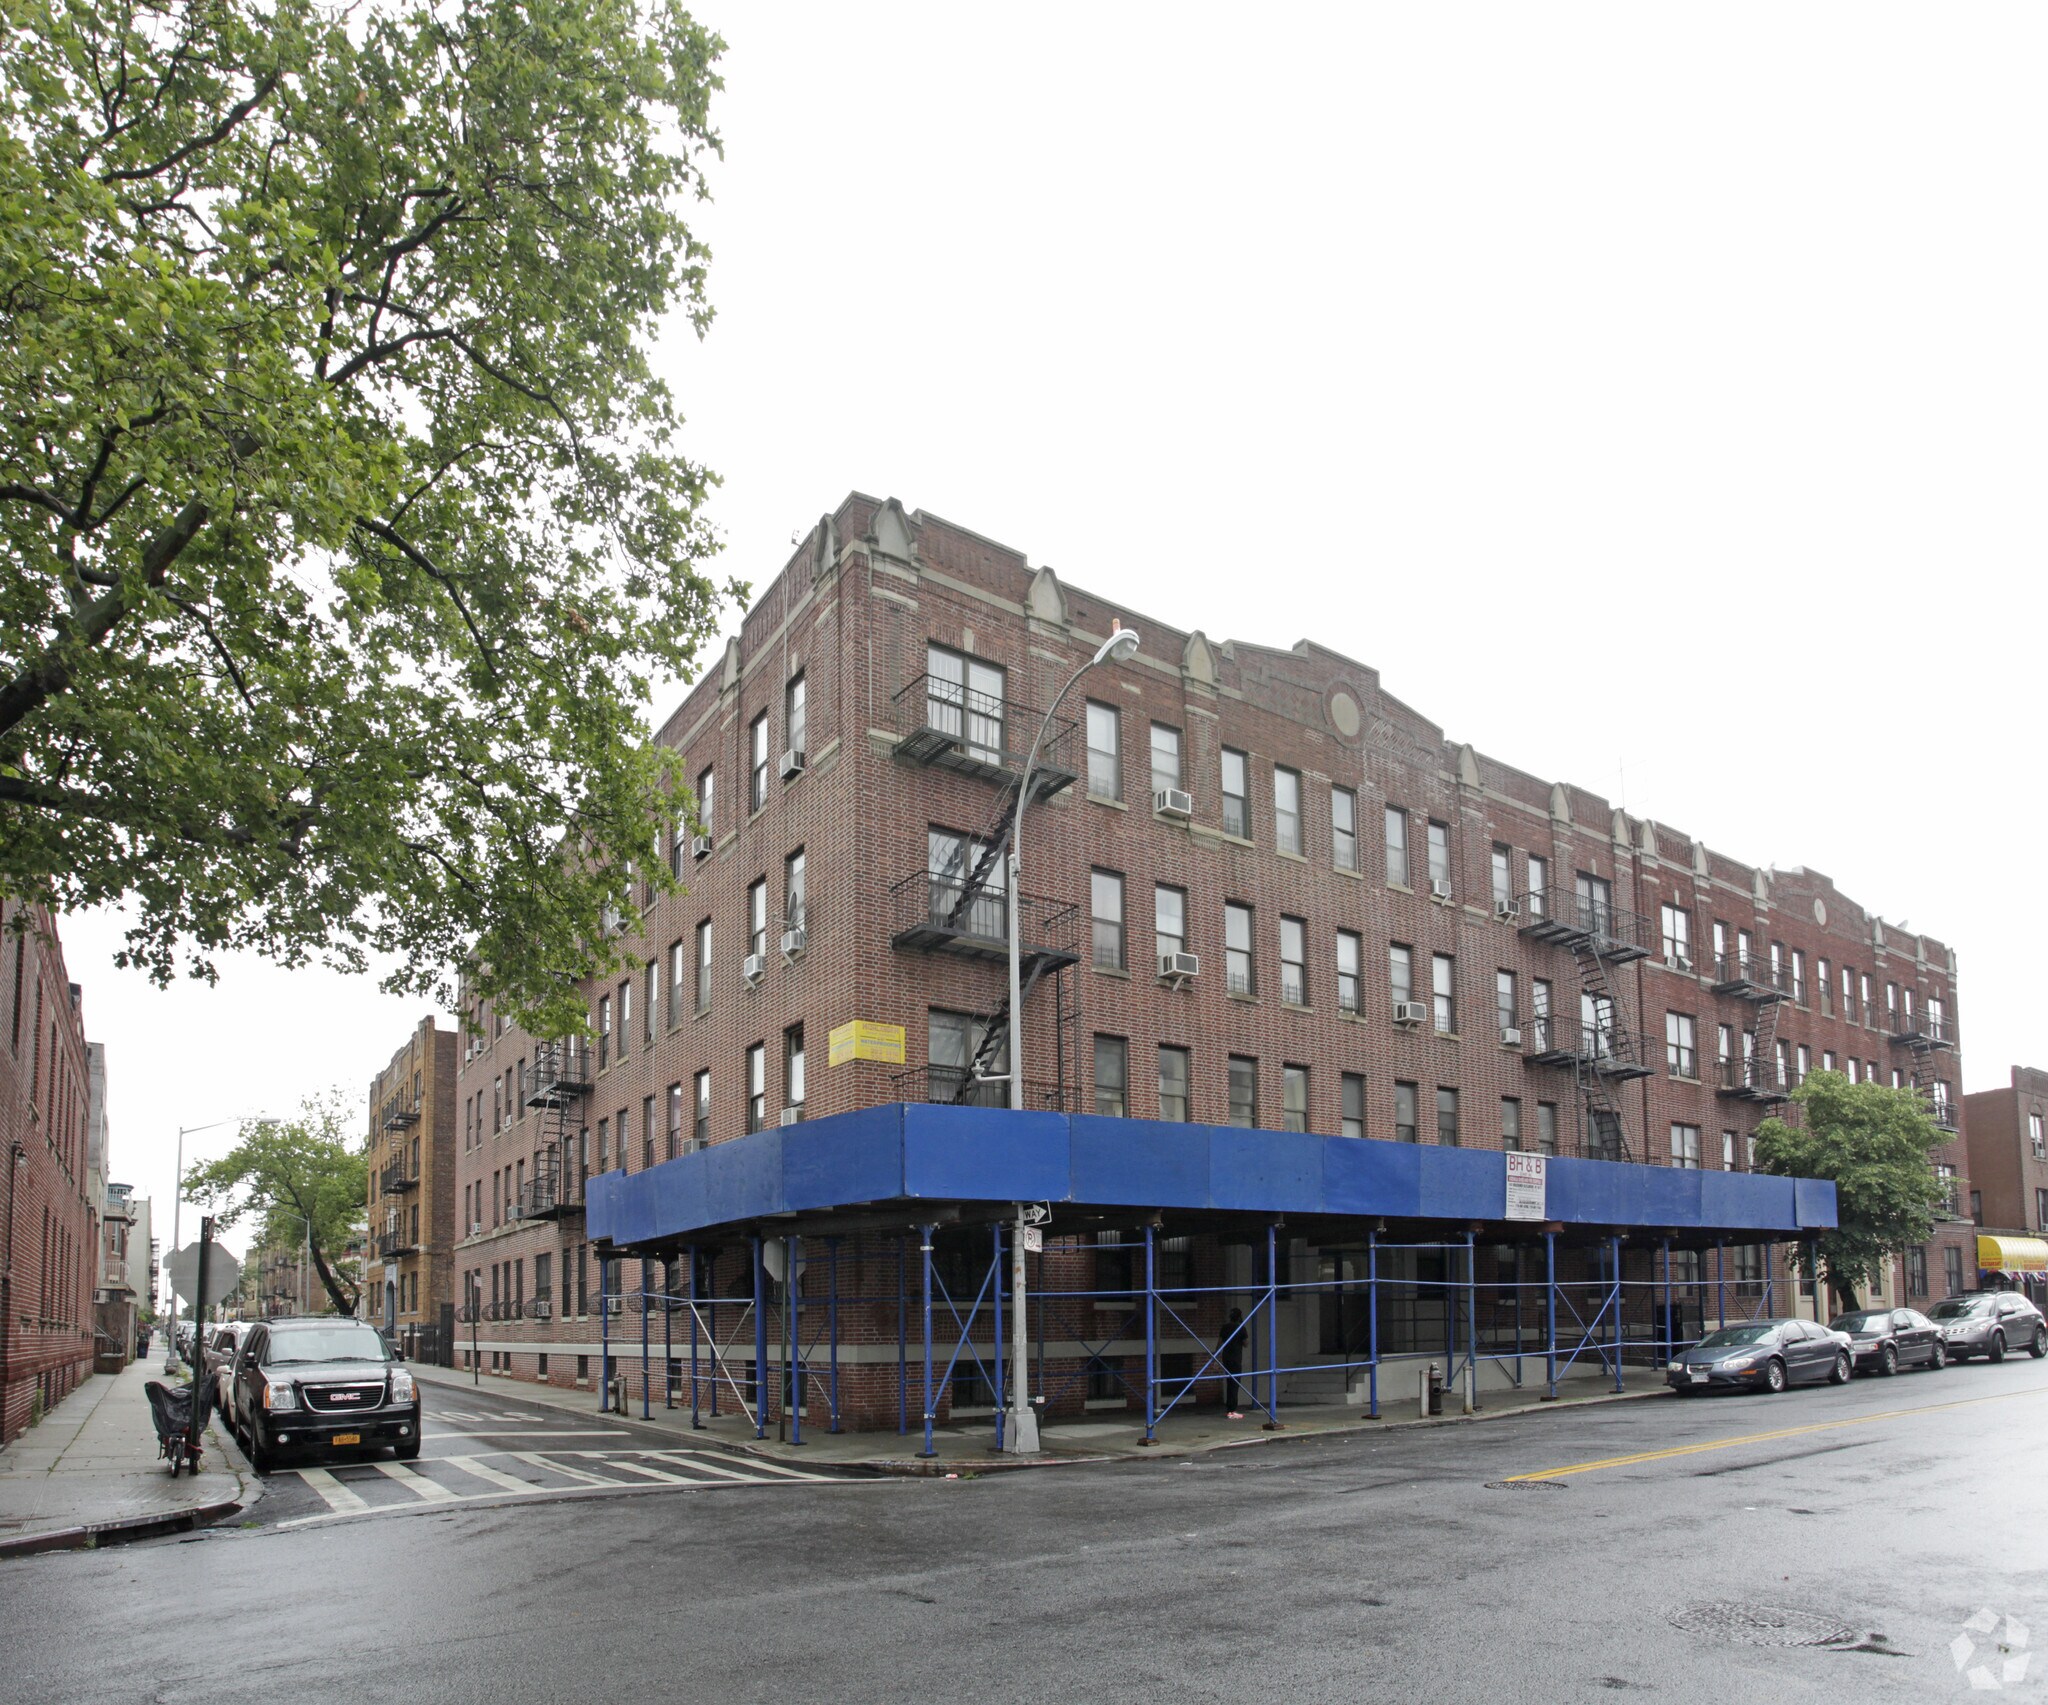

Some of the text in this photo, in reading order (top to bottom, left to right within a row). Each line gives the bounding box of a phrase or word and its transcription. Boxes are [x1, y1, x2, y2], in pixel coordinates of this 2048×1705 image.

[1509, 1156, 1542, 1173] BH & B
[1025, 1209, 1041, 1219] WAY
[330, 1393, 361, 1401] GMC
